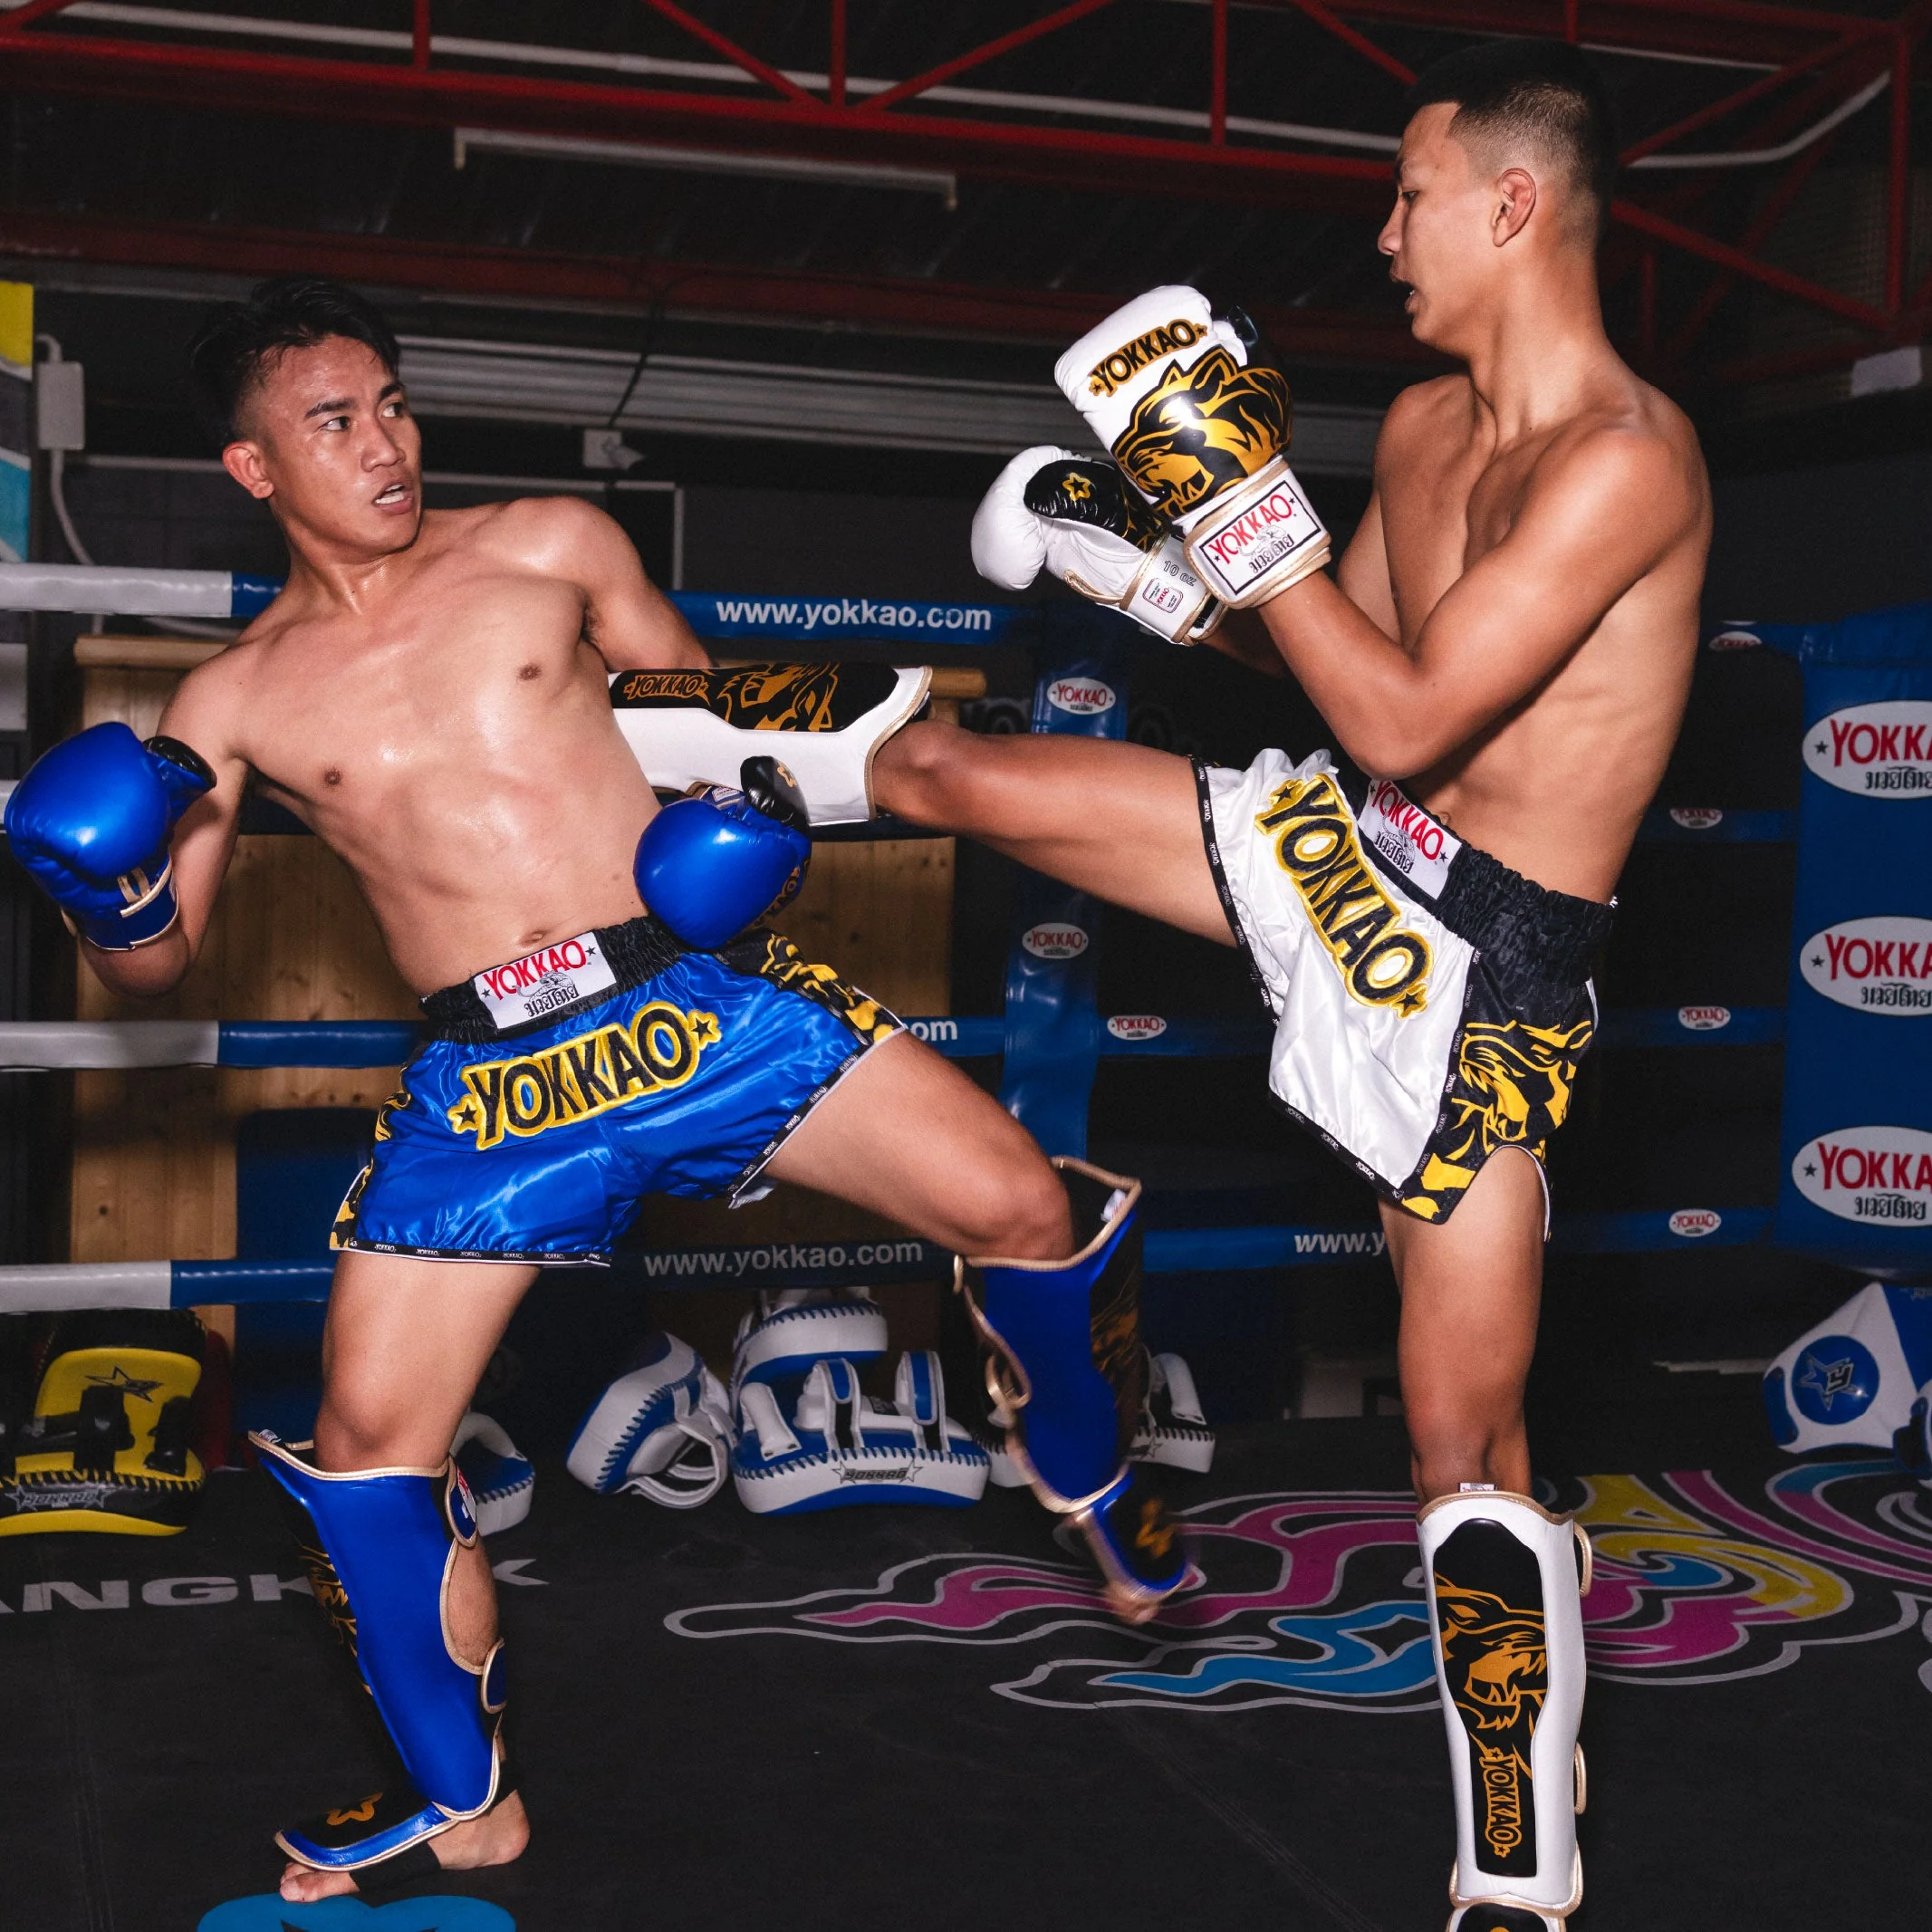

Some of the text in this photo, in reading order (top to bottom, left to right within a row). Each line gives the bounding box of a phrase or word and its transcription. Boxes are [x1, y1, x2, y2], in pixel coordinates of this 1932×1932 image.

[1090, 320, 1198, 396] YOKKAO
[1208, 494, 1293, 564] YOKKAO
[1163, 560, 1179, 577] 10
[716, 598, 992, 630] www.yokkao.com
[629, 674, 705, 700] YOKKAO
[1056, 683, 1108, 706] YOKKAO
[1371, 780, 1445, 860] YOKKAO
[1255, 774, 1433, 1006] YOKKAO
[1031, 930, 1083, 948] YOKKAO
[483, 940, 587, 1001] YOKKAO
[1114, 1017, 1160, 1031] YOKKAO
[464, 1001, 699, 1150] YOKKAO
[1677, 1213, 1716, 1228] YOKKAO
[644, 1241, 923, 1277] www.yokkao.com
[1481, 1754, 1522, 1848] YOKKAO
